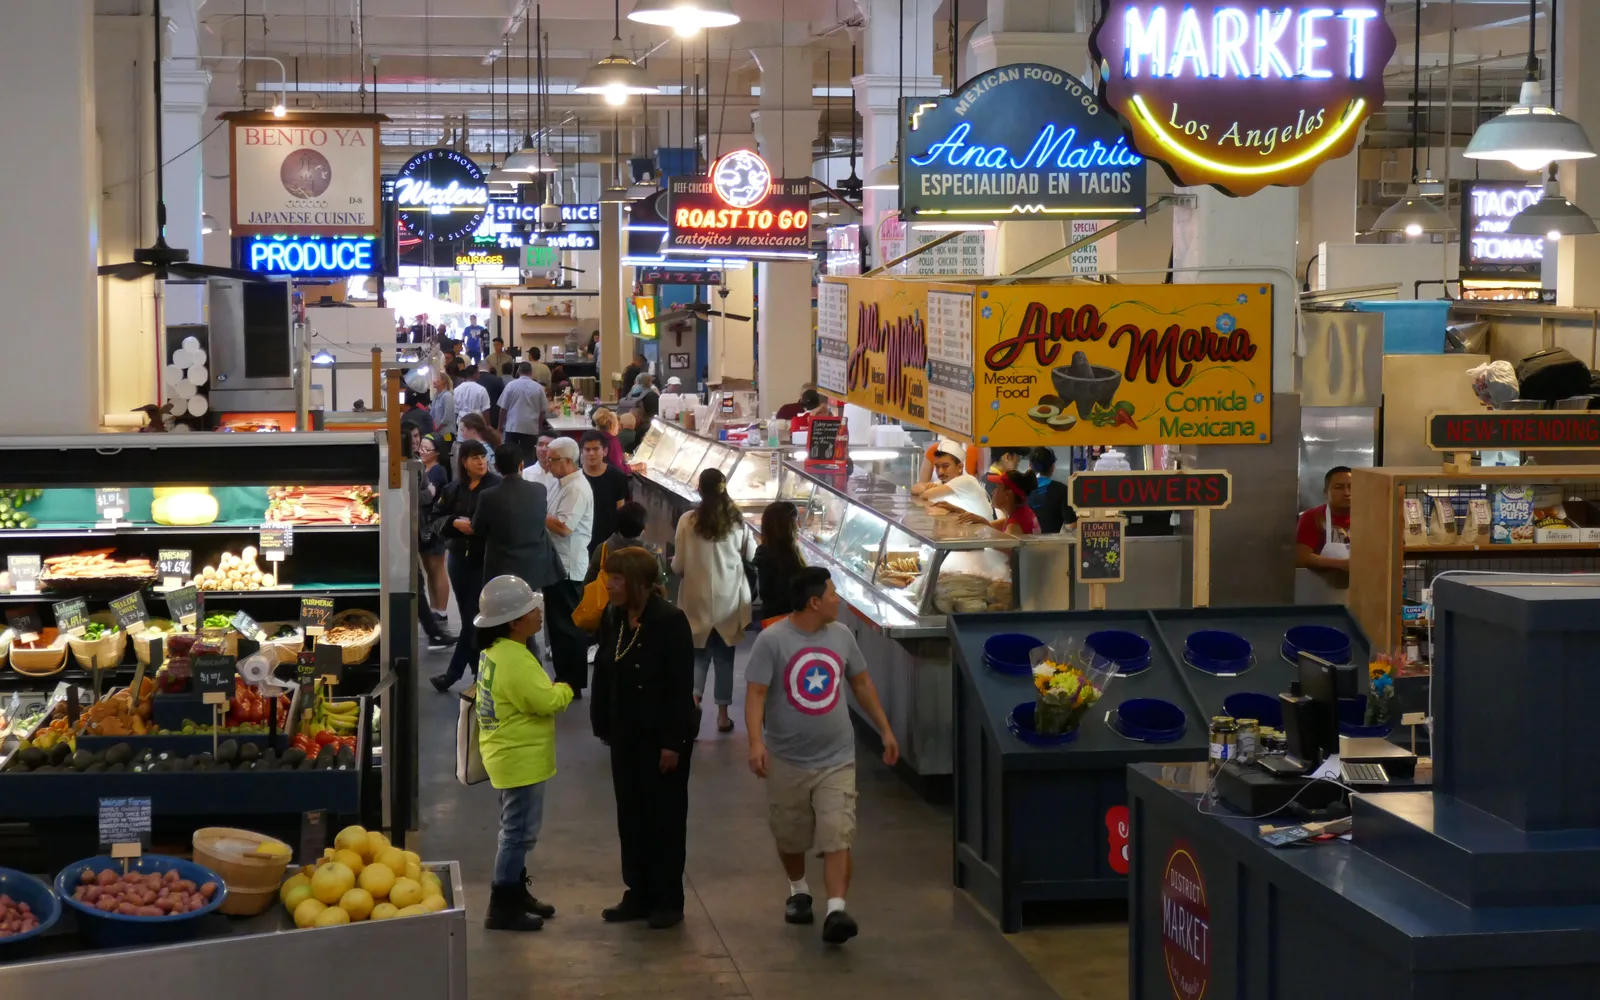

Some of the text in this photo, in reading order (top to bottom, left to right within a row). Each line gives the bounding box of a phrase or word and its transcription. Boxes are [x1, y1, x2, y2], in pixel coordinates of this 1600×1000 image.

[1124, 6, 1378, 80] MARKET
[955, 68, 1099, 116] MEXICAN FOOD TO GO
[244, 128, 366, 147] BENTO YA
[1169, 102, 1325, 156] Los Angeles
[910, 122, 1008, 169] Ana
[404, 152, 480, 180] HOUSE SMOKED
[921, 171, 1132, 196] ESPECIALIDAD EN TACOS
[248, 211, 365, 225] JAPANESE CUISINE
[497, 206, 540, 221] STIC
[562, 206, 598, 220] RICE
[675, 208, 808, 230] ROAST TO GO
[401, 213, 434, 241] HAND
[448, 213, 480, 241] SLICED
[675, 231, 807, 250] antojitos mexicanos
[251, 242, 371, 271] PRODUCE
[456, 255, 504, 265] SAUSAGES
[527, 247, 553, 267] EXIT
[1072, 255, 1098, 264] SOPES
[647, 272, 722, 283] PIZZA
[985, 301, 1108, 371] Ana
[983, 372, 1038, 386] Mexican
[995, 386, 1030, 399] Food
[1164, 390, 1248, 413] Comida
[1159, 416, 1256, 438] Mexicana
[1082, 477, 1220, 503] FLOWERS
[1500, 502, 1529, 512] POLAR
[1501, 510, 1529, 520] PUFFS
[1082, 523, 1114, 531] FLOWER
[1084, 530, 1120, 538] BOUQUETS
[159, 551, 190, 561] PARSNIP
[110, 593, 138, 610] YELLOW
[301, 598, 334, 607] TURMERIC
[1170, 868, 1201, 905] DISTRICT
[1163, 894, 1209, 965] MARKET
